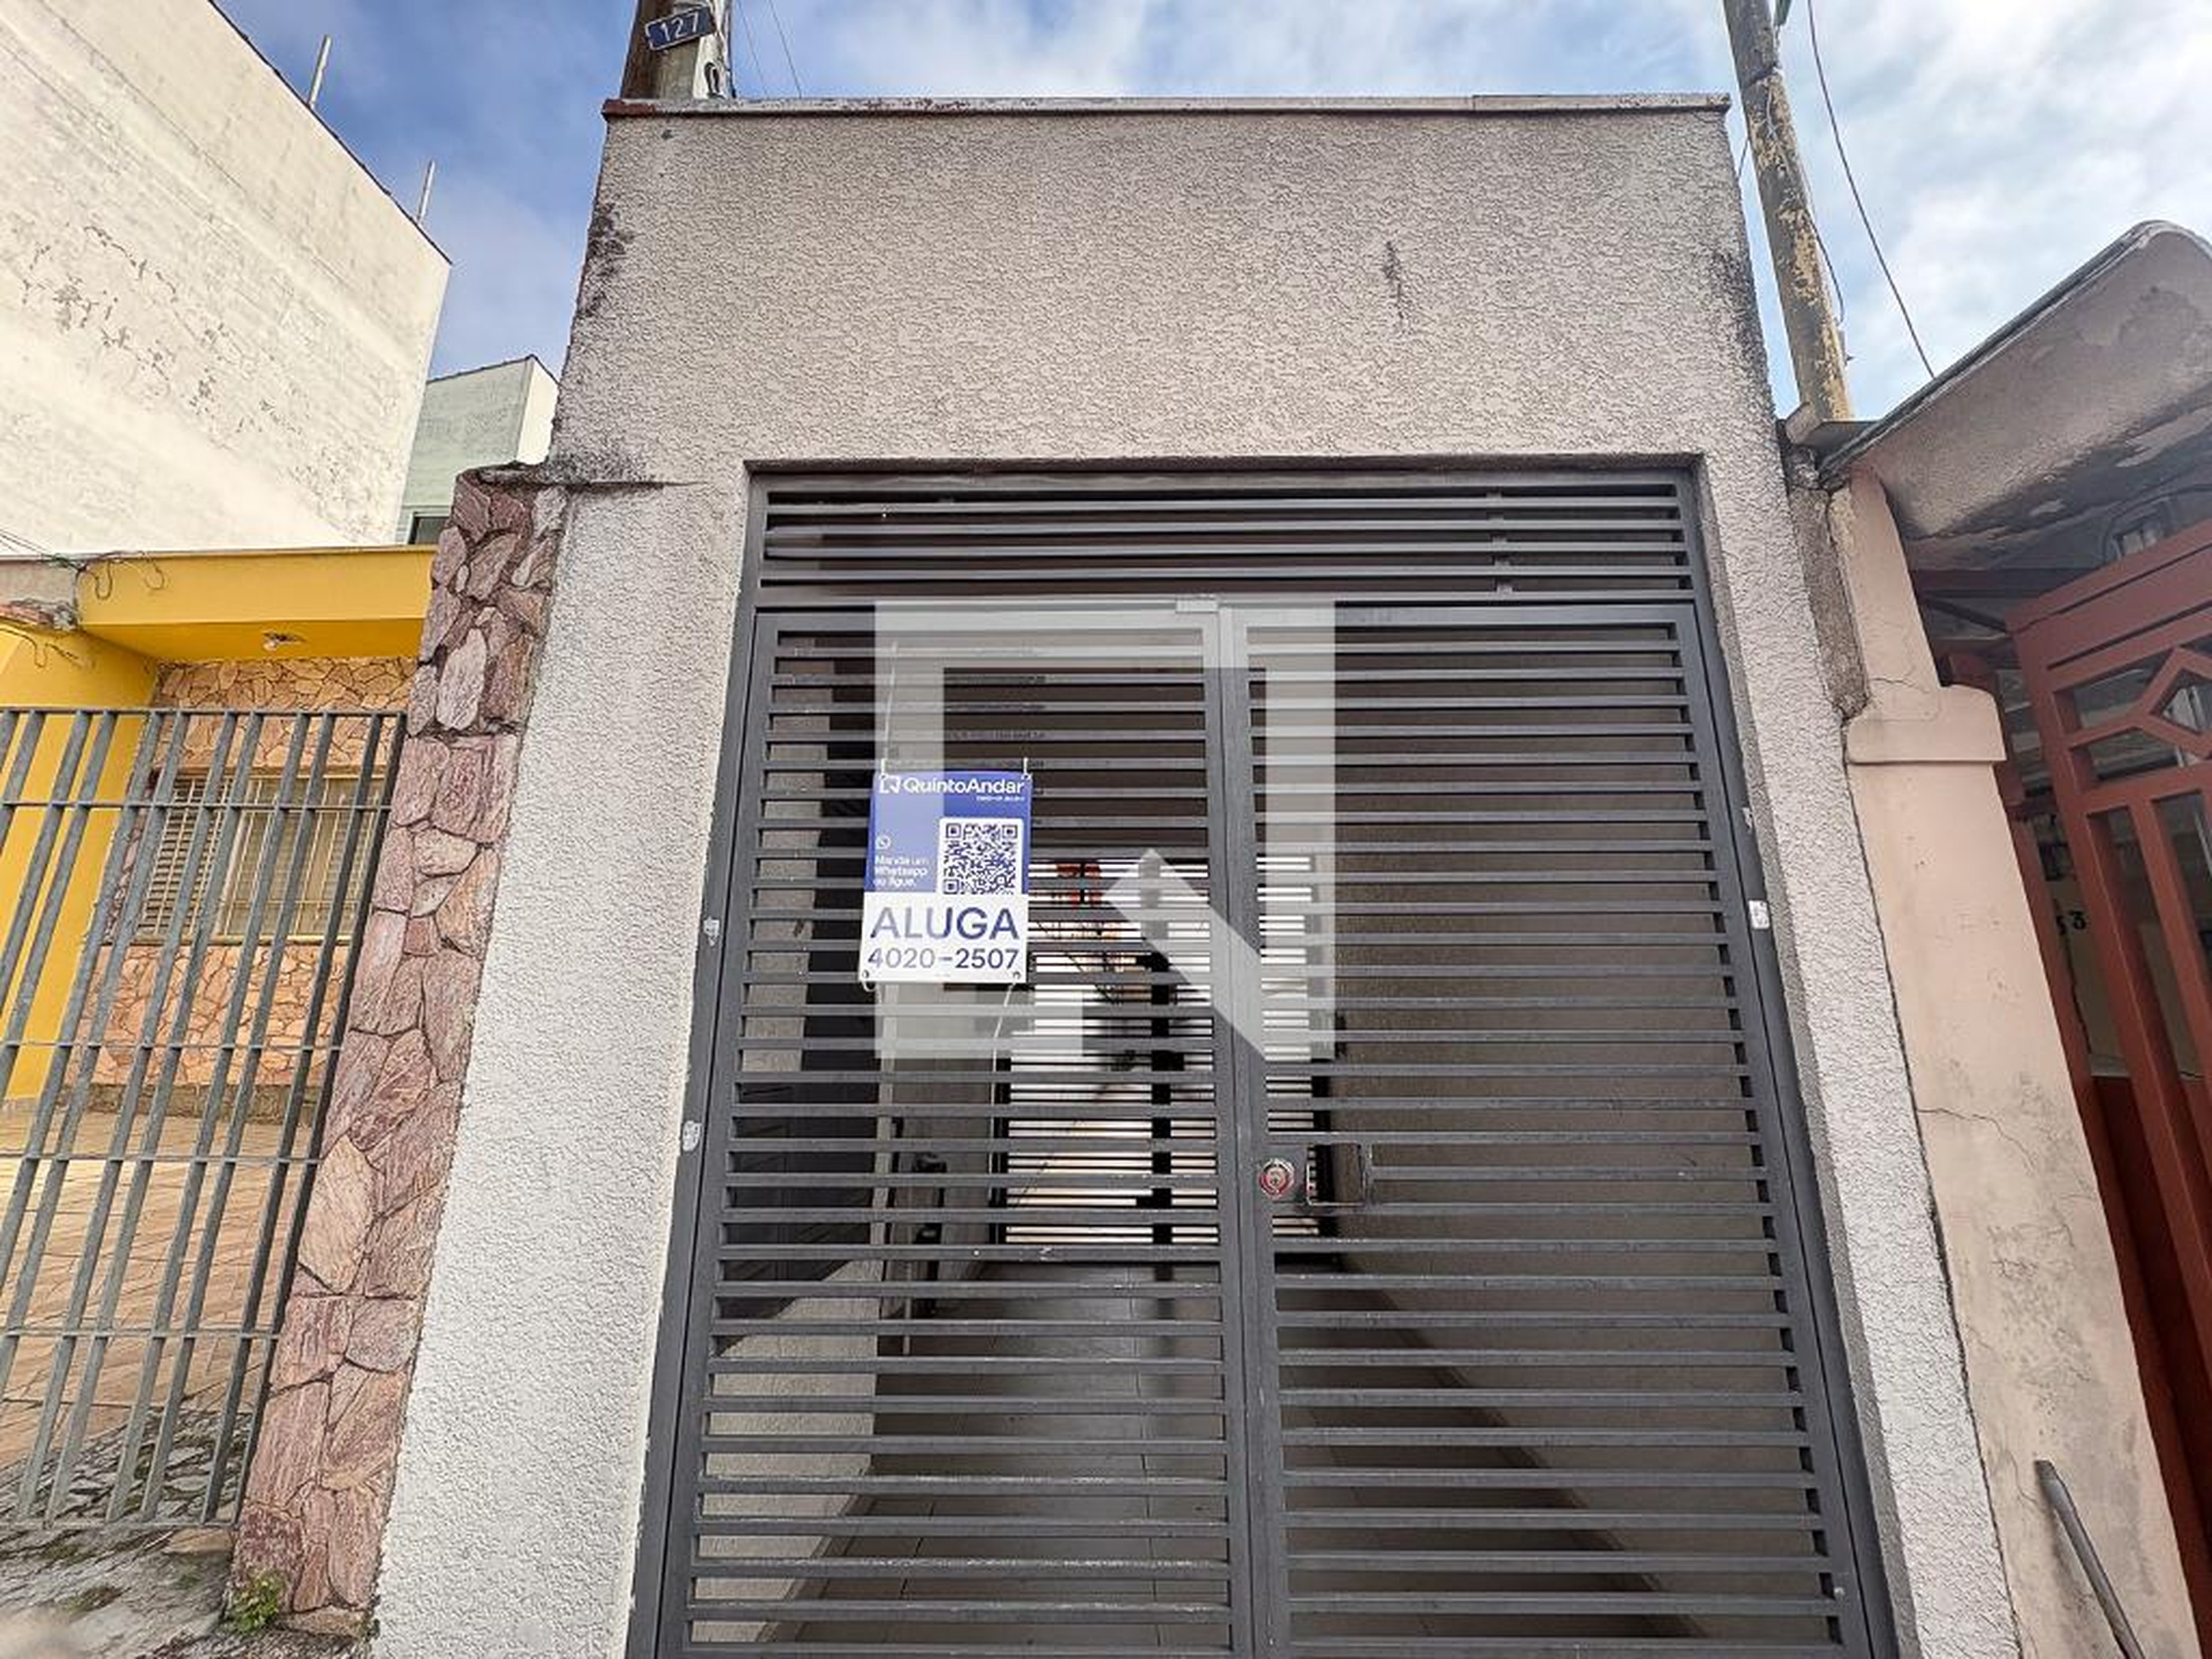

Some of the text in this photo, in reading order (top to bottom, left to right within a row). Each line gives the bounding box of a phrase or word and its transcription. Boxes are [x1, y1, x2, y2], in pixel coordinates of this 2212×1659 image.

[660, 12, 699, 42] 127
[904, 778, 1025, 794] QuintoAndar
[870, 907, 1019, 941] ALUGA
[868, 948, 1019, 968] 4020-2507
